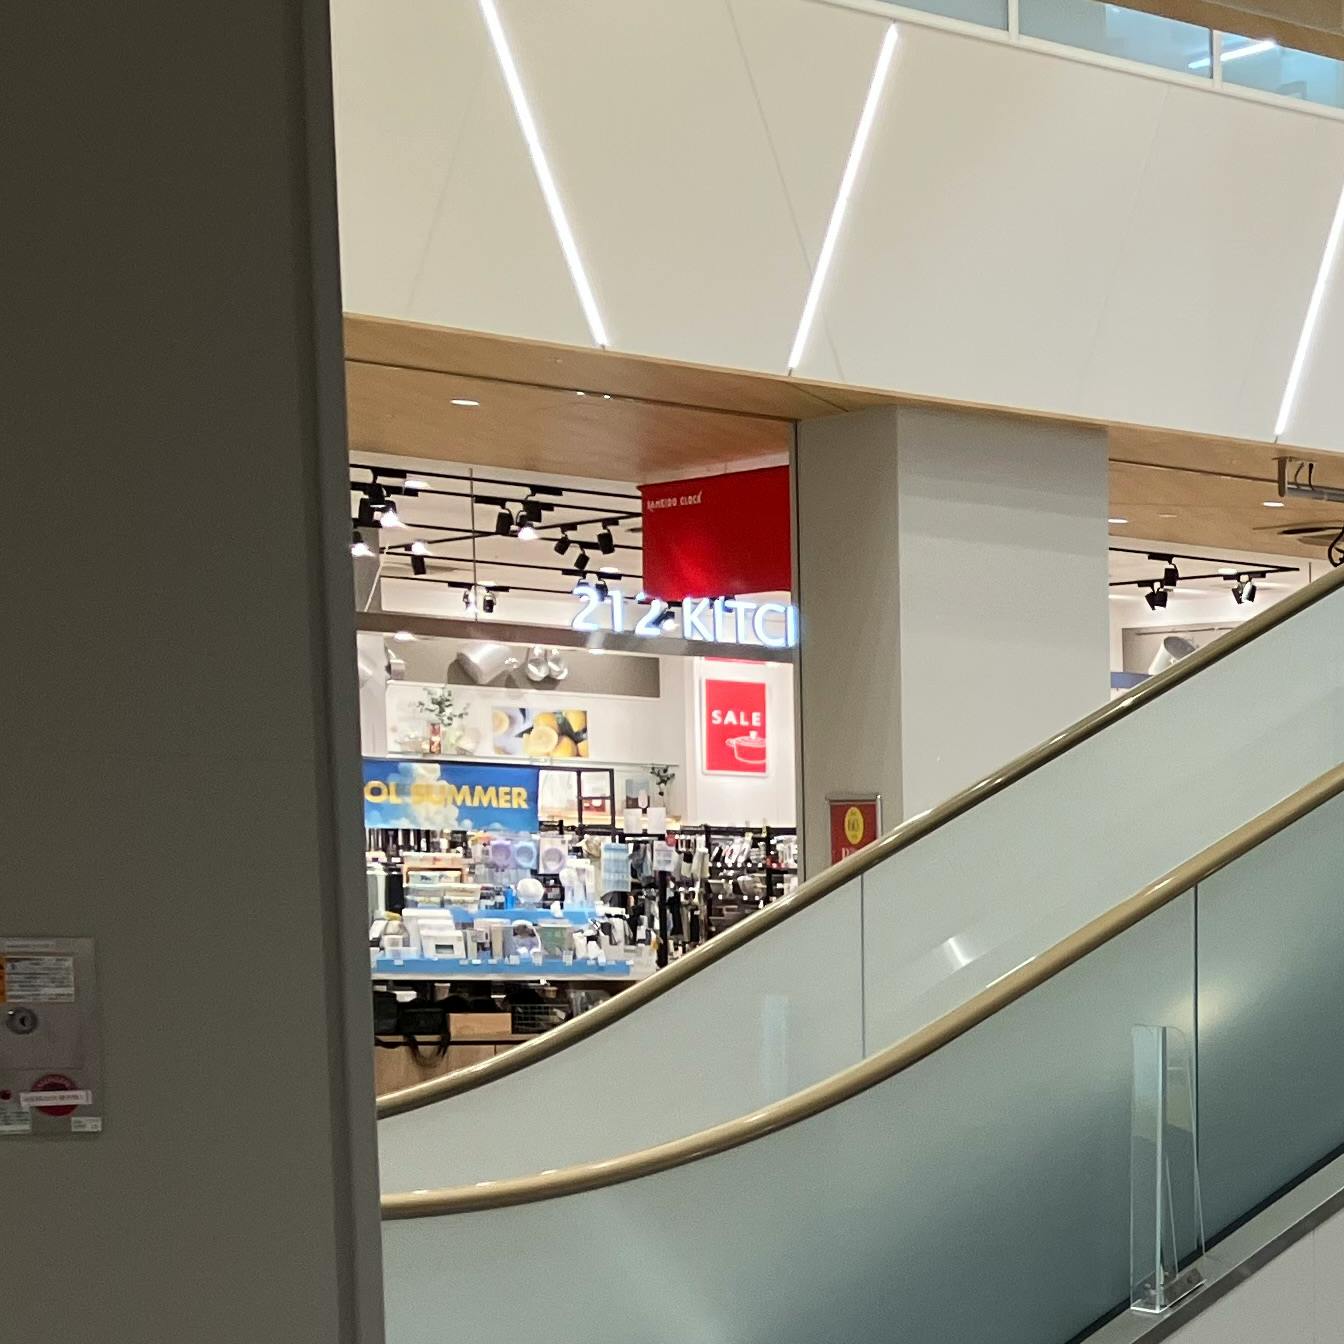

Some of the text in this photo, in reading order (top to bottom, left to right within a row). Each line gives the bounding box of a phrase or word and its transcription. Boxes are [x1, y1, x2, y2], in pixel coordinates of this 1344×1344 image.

[647, 490, 703, 512] KAMEIDO CLOCK
[571, 584, 668, 637] 212
[711, 709, 762, 727] SALE
[410, 783, 529, 809] SUMMER
